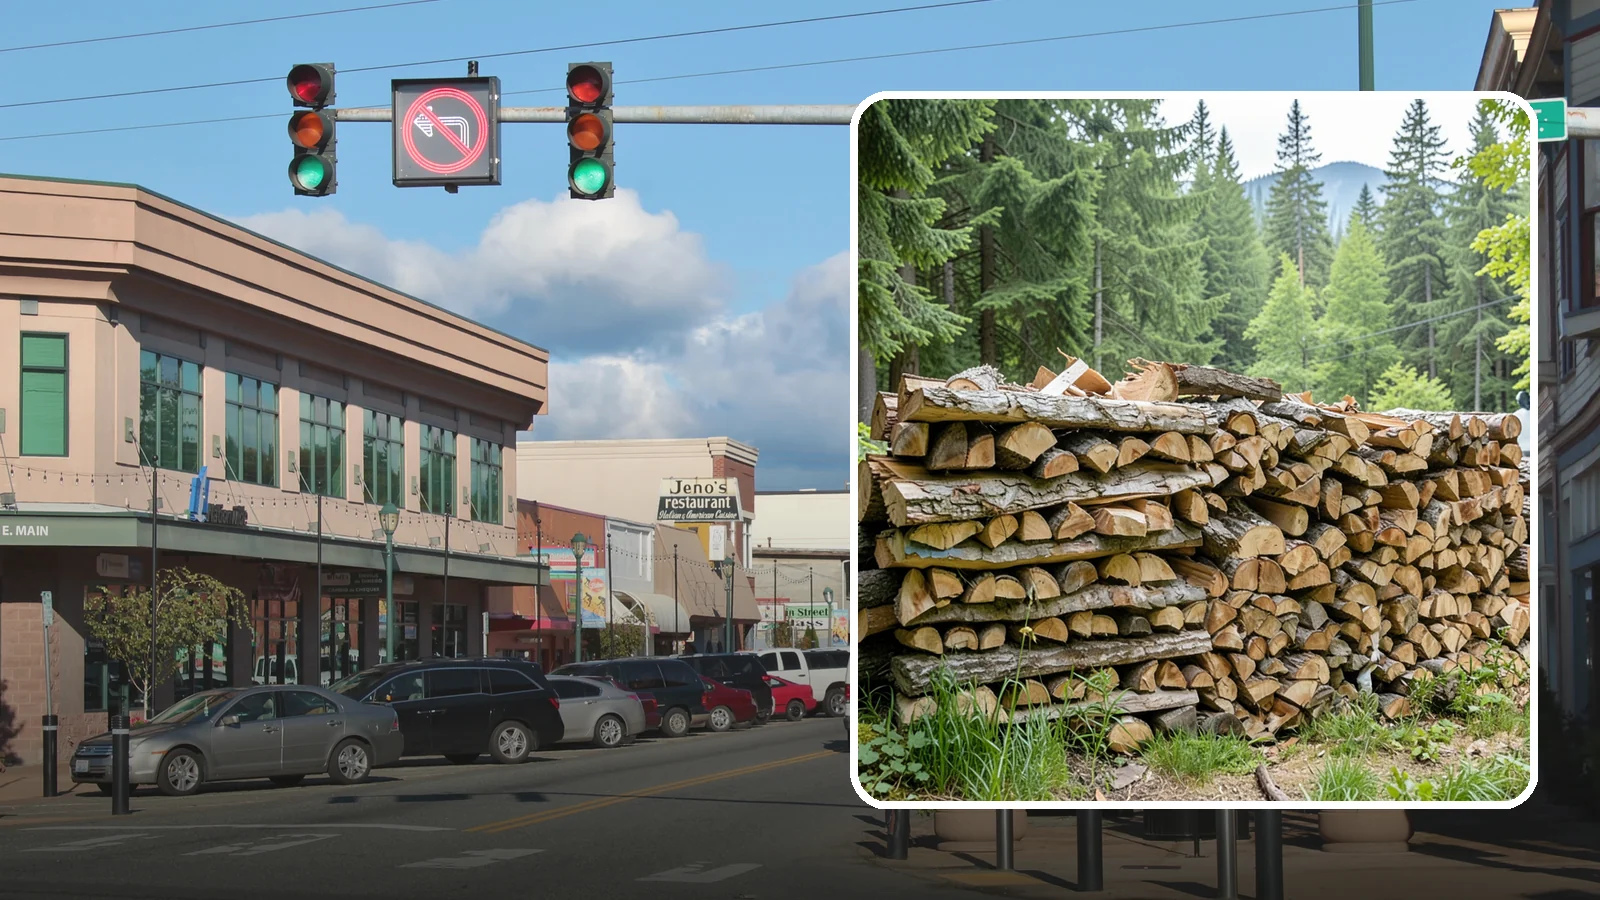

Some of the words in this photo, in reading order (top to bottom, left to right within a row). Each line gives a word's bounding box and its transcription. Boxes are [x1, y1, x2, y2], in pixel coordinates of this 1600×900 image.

[670, 480, 728, 495] Jeno's
[665, 496, 731, 509] restaurant
[658, 510, 681, 520] Italian
[685, 510, 714, 519] American
[715, 509, 737, 519] Cuisine
[2, 525, 13, 536] E.
[15, 525, 49, 536] MAIN
[797, 607, 828, 616] Street
